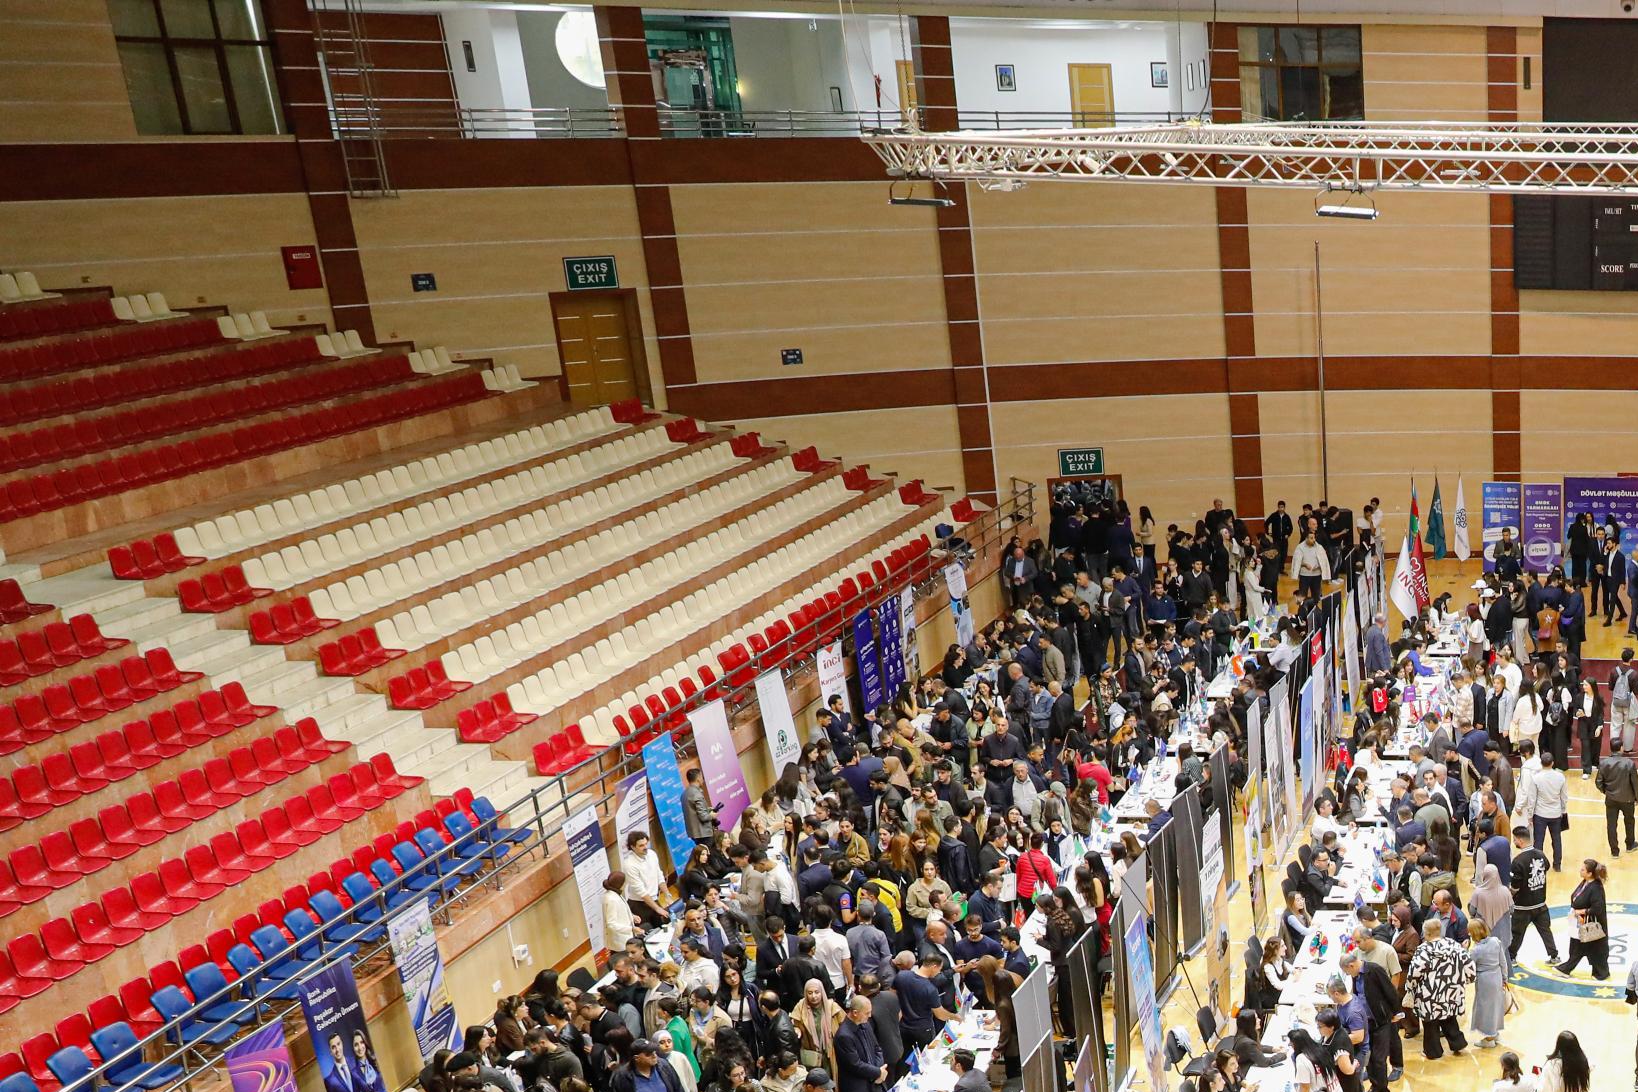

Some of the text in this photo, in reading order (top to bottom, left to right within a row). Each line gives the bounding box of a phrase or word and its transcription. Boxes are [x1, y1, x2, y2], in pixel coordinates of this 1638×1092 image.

[573, 262, 608, 275] ÇIXIŞ
[1601, 265, 1624, 273] SCORE
[577, 274, 607, 284] EXIT
[1065, 451, 1096, 463] ÇIXIŞ
[1069, 462, 1095, 471] EXIT
[1580, 489, 1605, 498] DÖVLƏT
[307, 988, 321, 1000] Bank
[308, 986, 337, 1007] Respublika
[313, 1006, 334, 1023] Peşəkar
